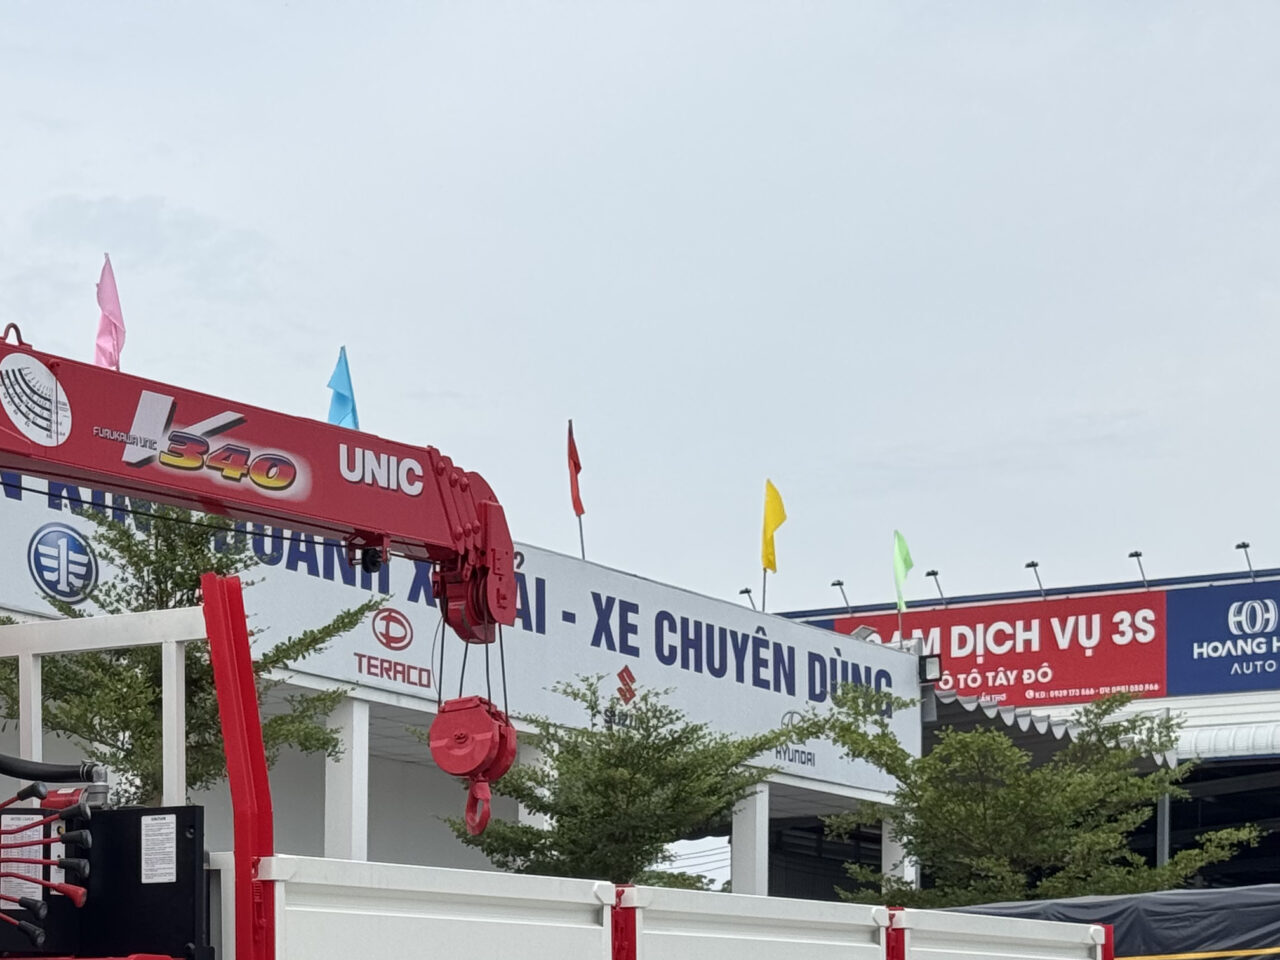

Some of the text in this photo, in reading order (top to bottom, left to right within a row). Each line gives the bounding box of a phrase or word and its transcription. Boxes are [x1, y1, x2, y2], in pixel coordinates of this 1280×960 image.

[93, 426, 139, 448] FURUKAWA
[338, 443, 424, 497] UNIC
[590, 591, 640, 658] XE
[654, 610, 796, 698] CHUYÊN
[950, 619, 1040, 664] DỊCH
[1051, 613, 1101, 657] VỤ
[1111, 609, 1156, 646] 3S
[1193, 637, 1268, 660] HOANG
[353, 652, 432, 688] TERACO
[957, 668, 982, 689] TÔ
[985, 666, 1018, 687] TÂY
[1022, 663, 1053, 685] ĐÔ
[1230, 660, 1277, 675] AUTO
[775, 743, 816, 768] HYUNDAI
